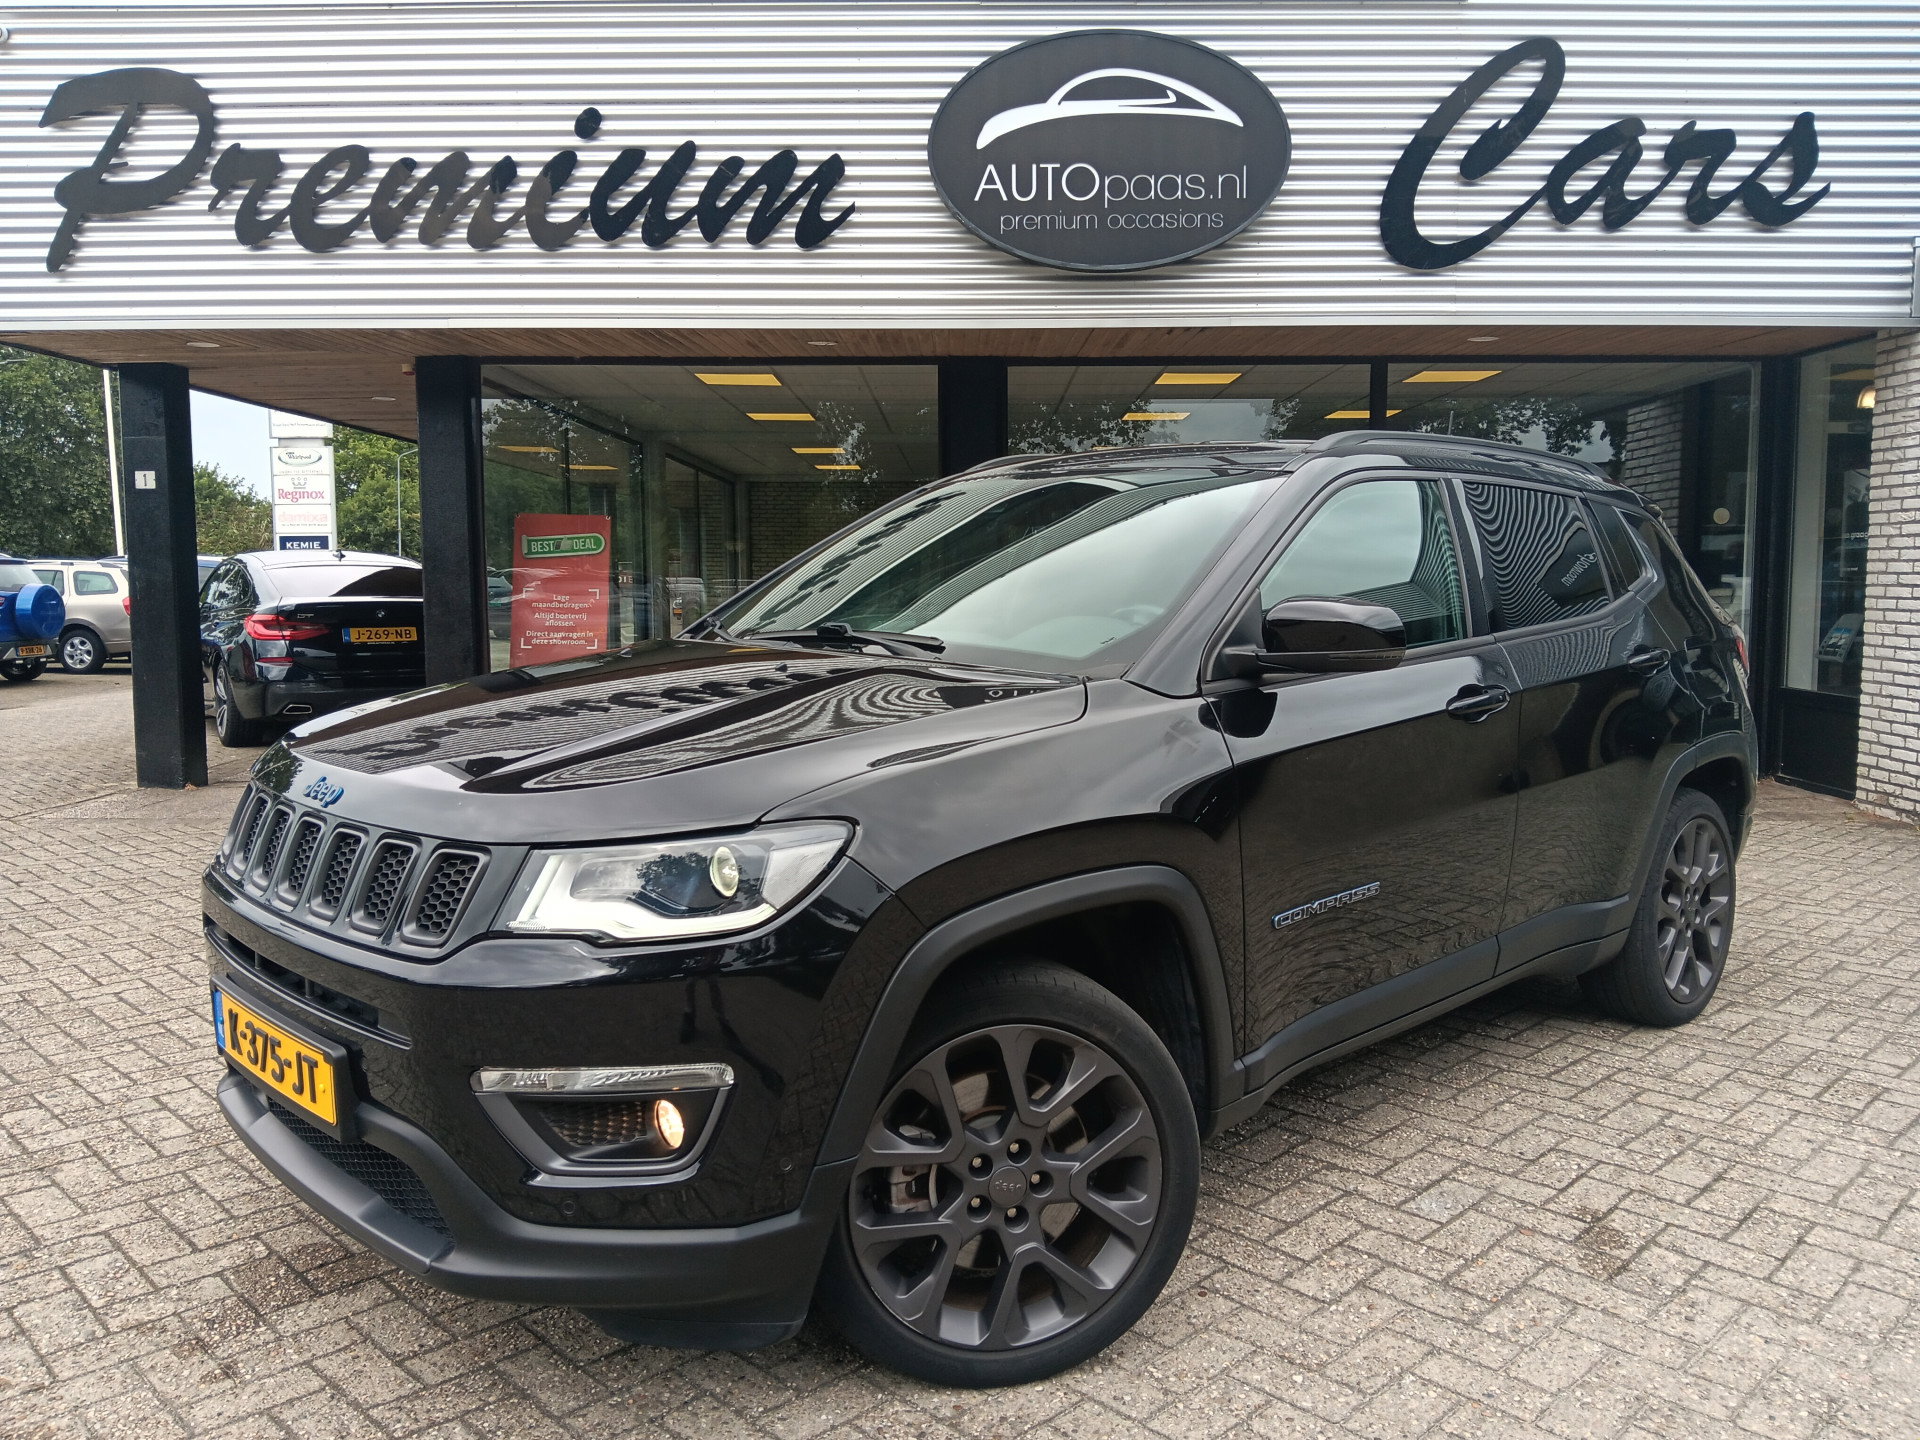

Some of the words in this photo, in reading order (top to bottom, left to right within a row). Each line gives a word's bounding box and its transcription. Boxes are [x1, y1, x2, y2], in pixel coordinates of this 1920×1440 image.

[38, 67, 856, 272] Premium
[1380, 37, 1831, 270] Cars
[974, 162, 1247, 209] AUTOpaas.nl
[1000, 210, 1098, 234] premium
[1107, 208, 1224, 229] occasions
[278, 488, 325, 503] Reginox
[286, 541, 321, 549] KEMIE
[531, 540, 555, 552] BEST
[573, 538, 597, 550] DEAL
[553, 594, 570, 602] Lage
[534, 612, 555, 620] Altijd
[555, 612, 588, 621] boetevrij
[354, 628, 413, 641] J-269-NB
[549, 631, 586, 639] aanvragen
[303, 776, 345, 809] Jeep
[1271, 881, 1381, 930] COMPASS
[228, 1007, 319, 1104] K-375-JT
